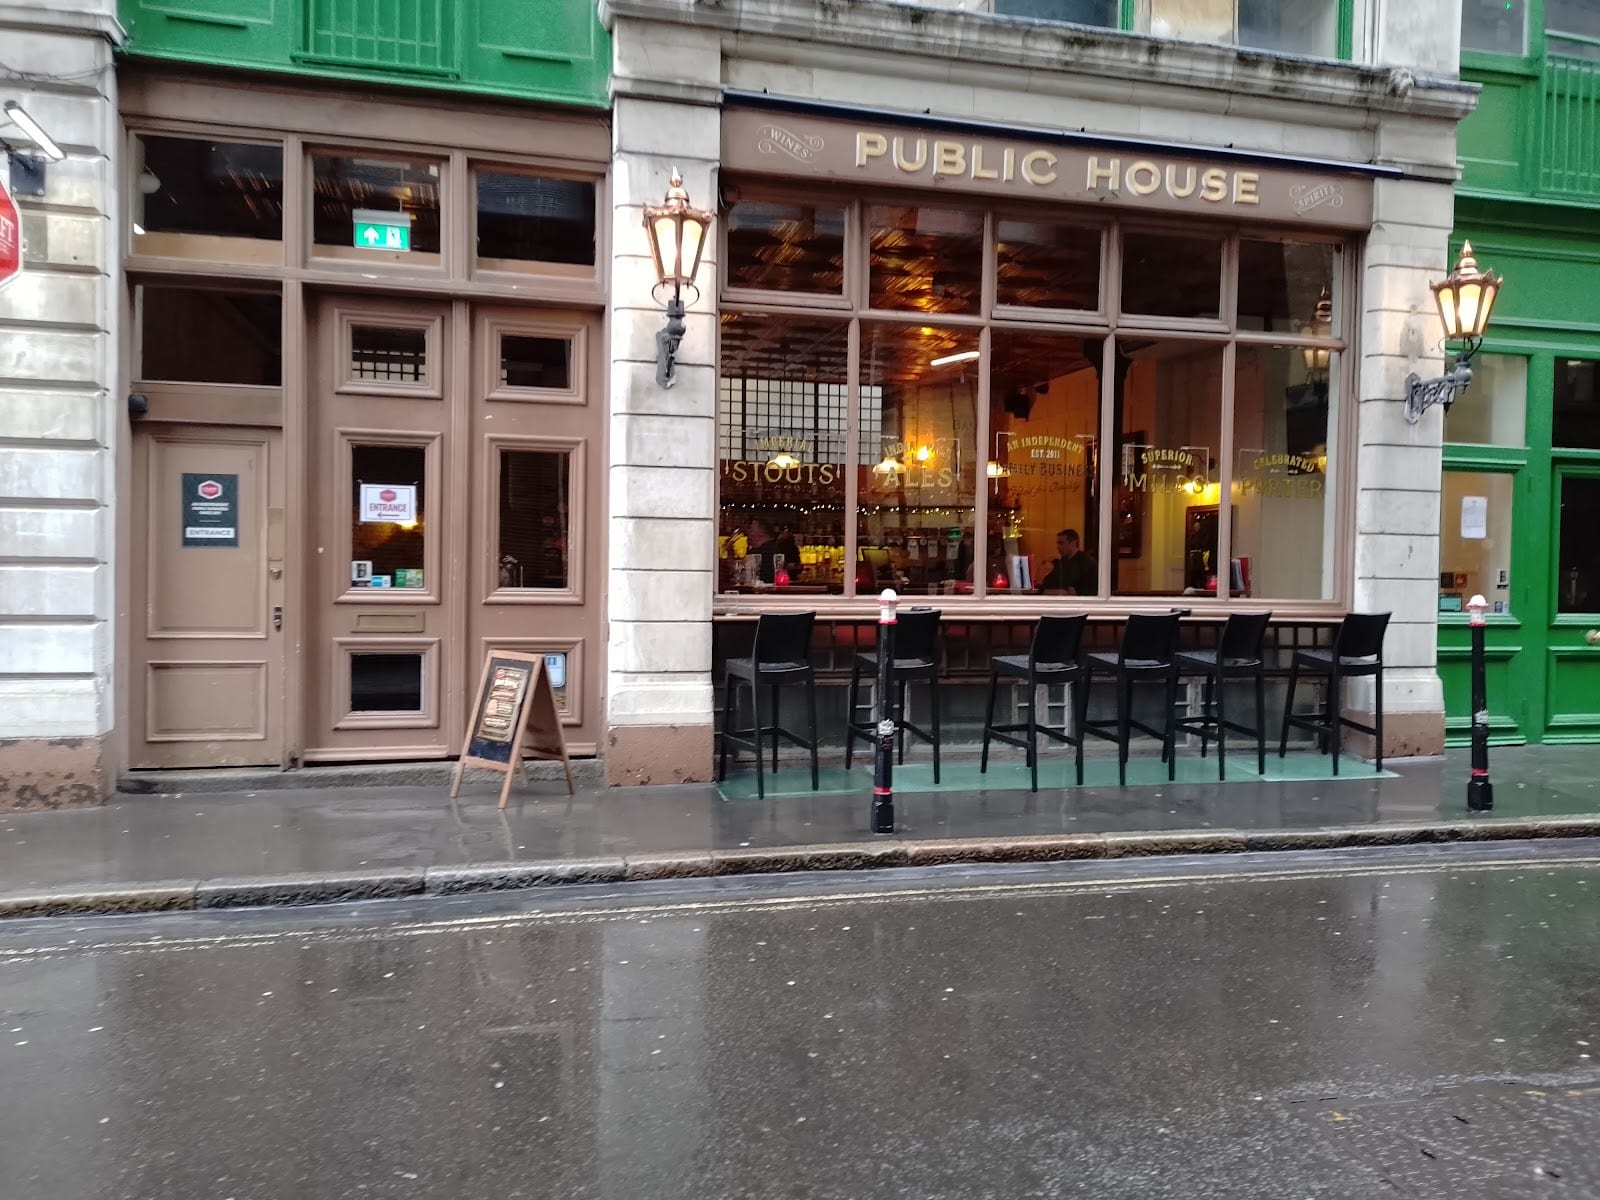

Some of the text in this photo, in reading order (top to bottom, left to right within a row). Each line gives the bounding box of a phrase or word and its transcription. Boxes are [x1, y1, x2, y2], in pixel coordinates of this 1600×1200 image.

[771, 127, 809, 158] WINES
[855, 131, 1260, 204] PUBLIC HOUSE
[1007, 435, 1084, 454] AN INDEPENDENT
[732, 461, 834, 485] STOUTS
[1253, 453, 1315, 473] CELEBRATED
[883, 466, 953, 488] ALES
[369, 503, 407, 512] ENTRANCE
